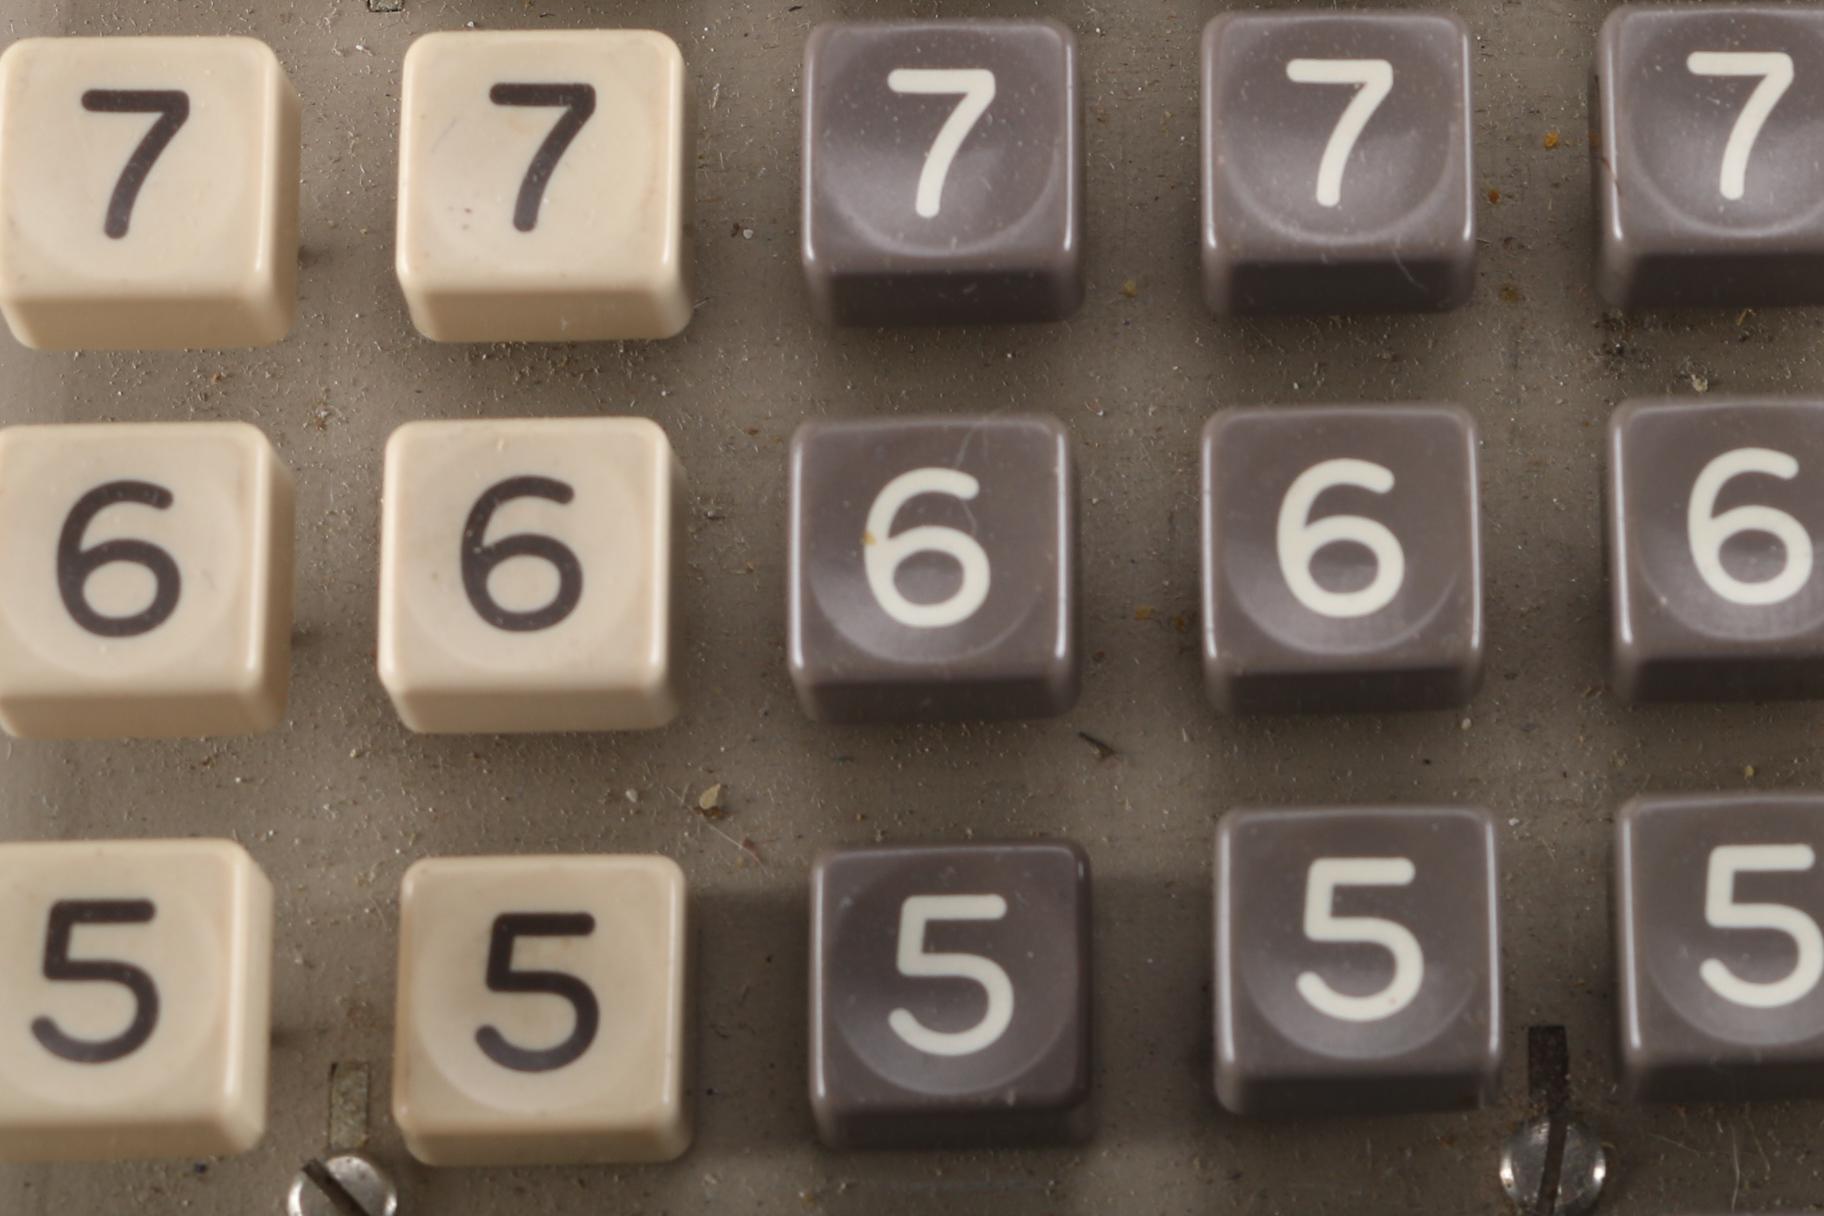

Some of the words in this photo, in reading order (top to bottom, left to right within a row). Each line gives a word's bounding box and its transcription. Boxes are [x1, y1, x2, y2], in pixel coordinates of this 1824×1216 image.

[81, 89, 189, 239] 7
[489, 83, 596, 232] 7
[888, 69, 995, 219] 7
[1287, 60, 1393, 207] 7
[1688, 52, 1793, 200] 7
[56, 480, 181, 637] 6
[460, 475, 582, 632] 6
[865, 469, 990, 628] 6
[1278, 459, 1404, 618] 6
[1689, 448, 1813, 607] 6
[32, 899, 159, 1064] 5
[476, 912, 599, 1072] 5
[889, 895, 1014, 1056] 5
[1296, 858, 1423, 1022] 5
[1700, 845, 1824, 1009] 5
